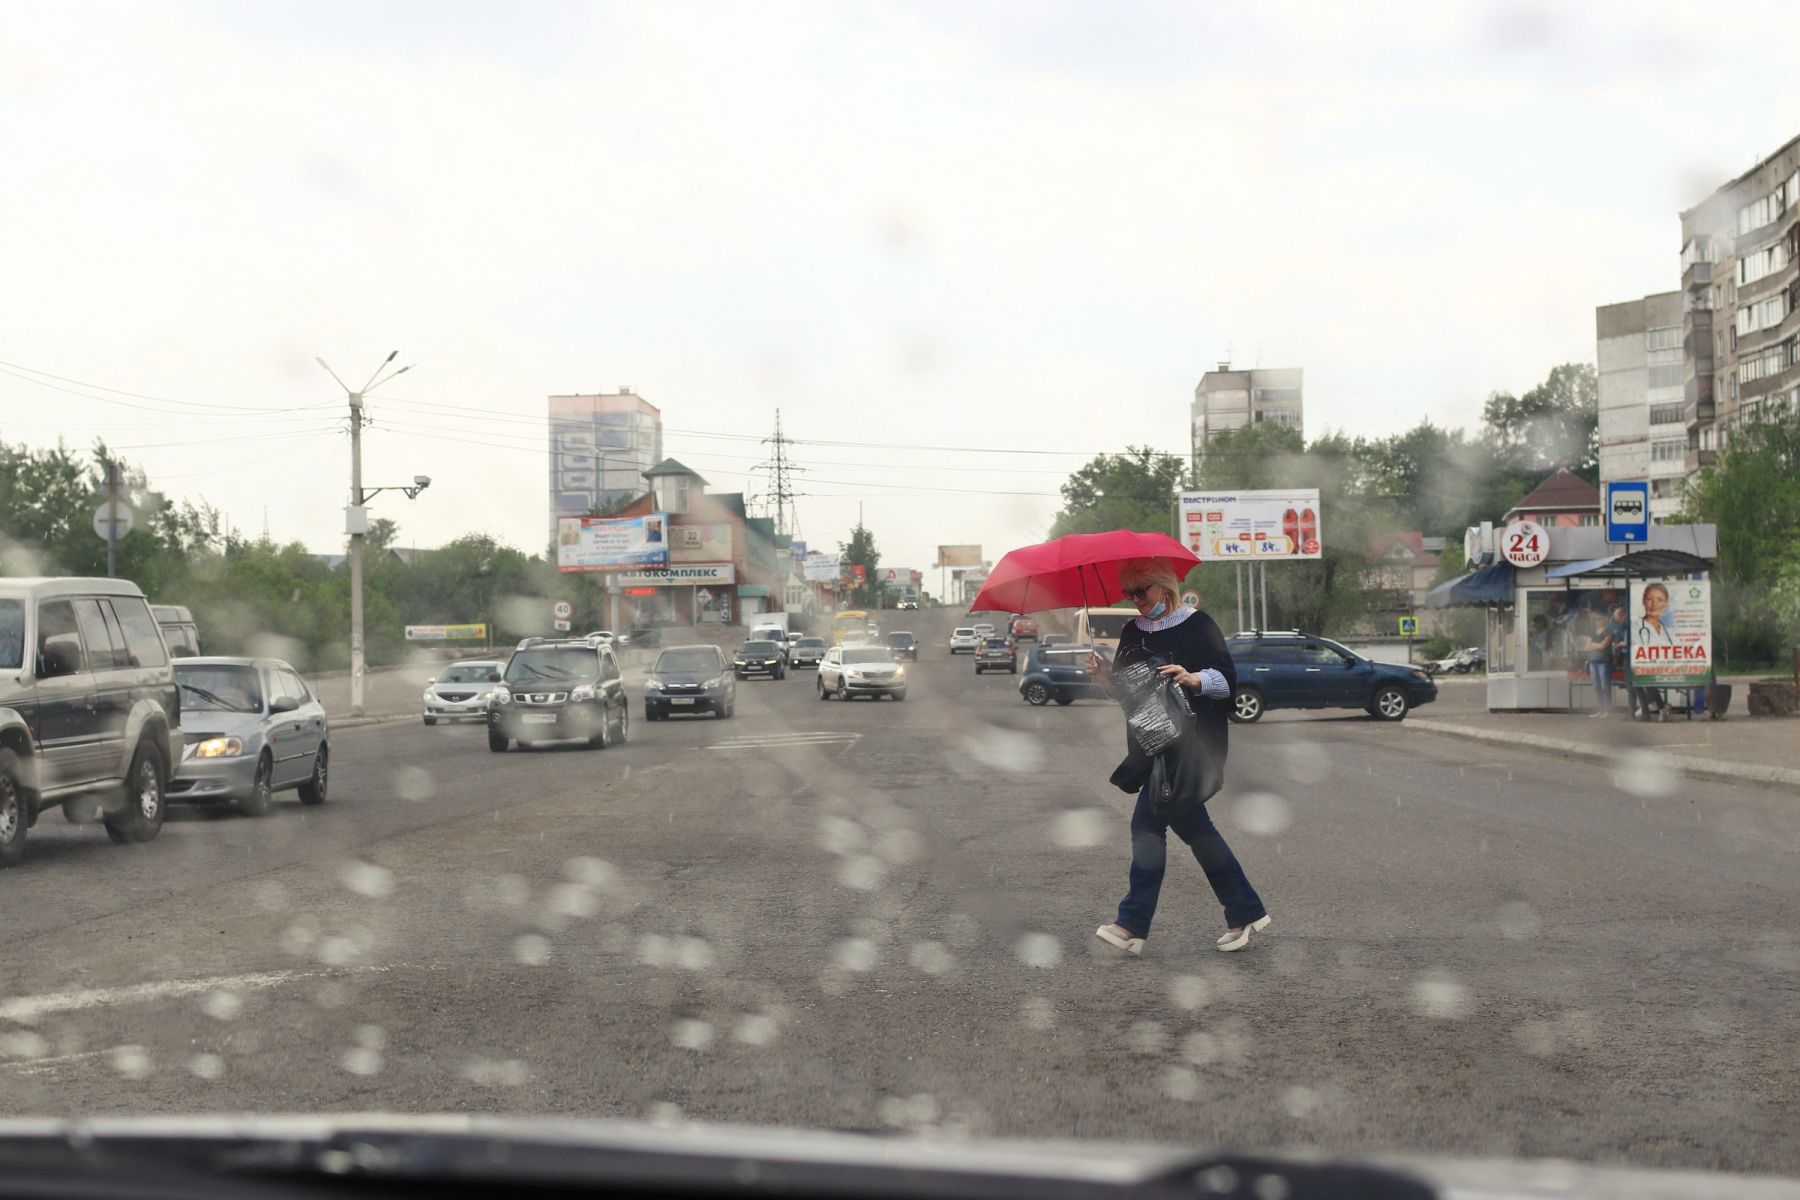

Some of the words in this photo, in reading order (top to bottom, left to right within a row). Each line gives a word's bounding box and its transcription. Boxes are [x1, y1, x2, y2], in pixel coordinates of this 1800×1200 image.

[687, 531, 698, 541] 22
[1510, 534, 1540, 552] 24
[1509, 553, 1541, 562] часа
[1184, 596, 1197, 604] 40
[556, 604, 569, 613] 40
[1635, 645, 1707, 660] АПТЕКА
